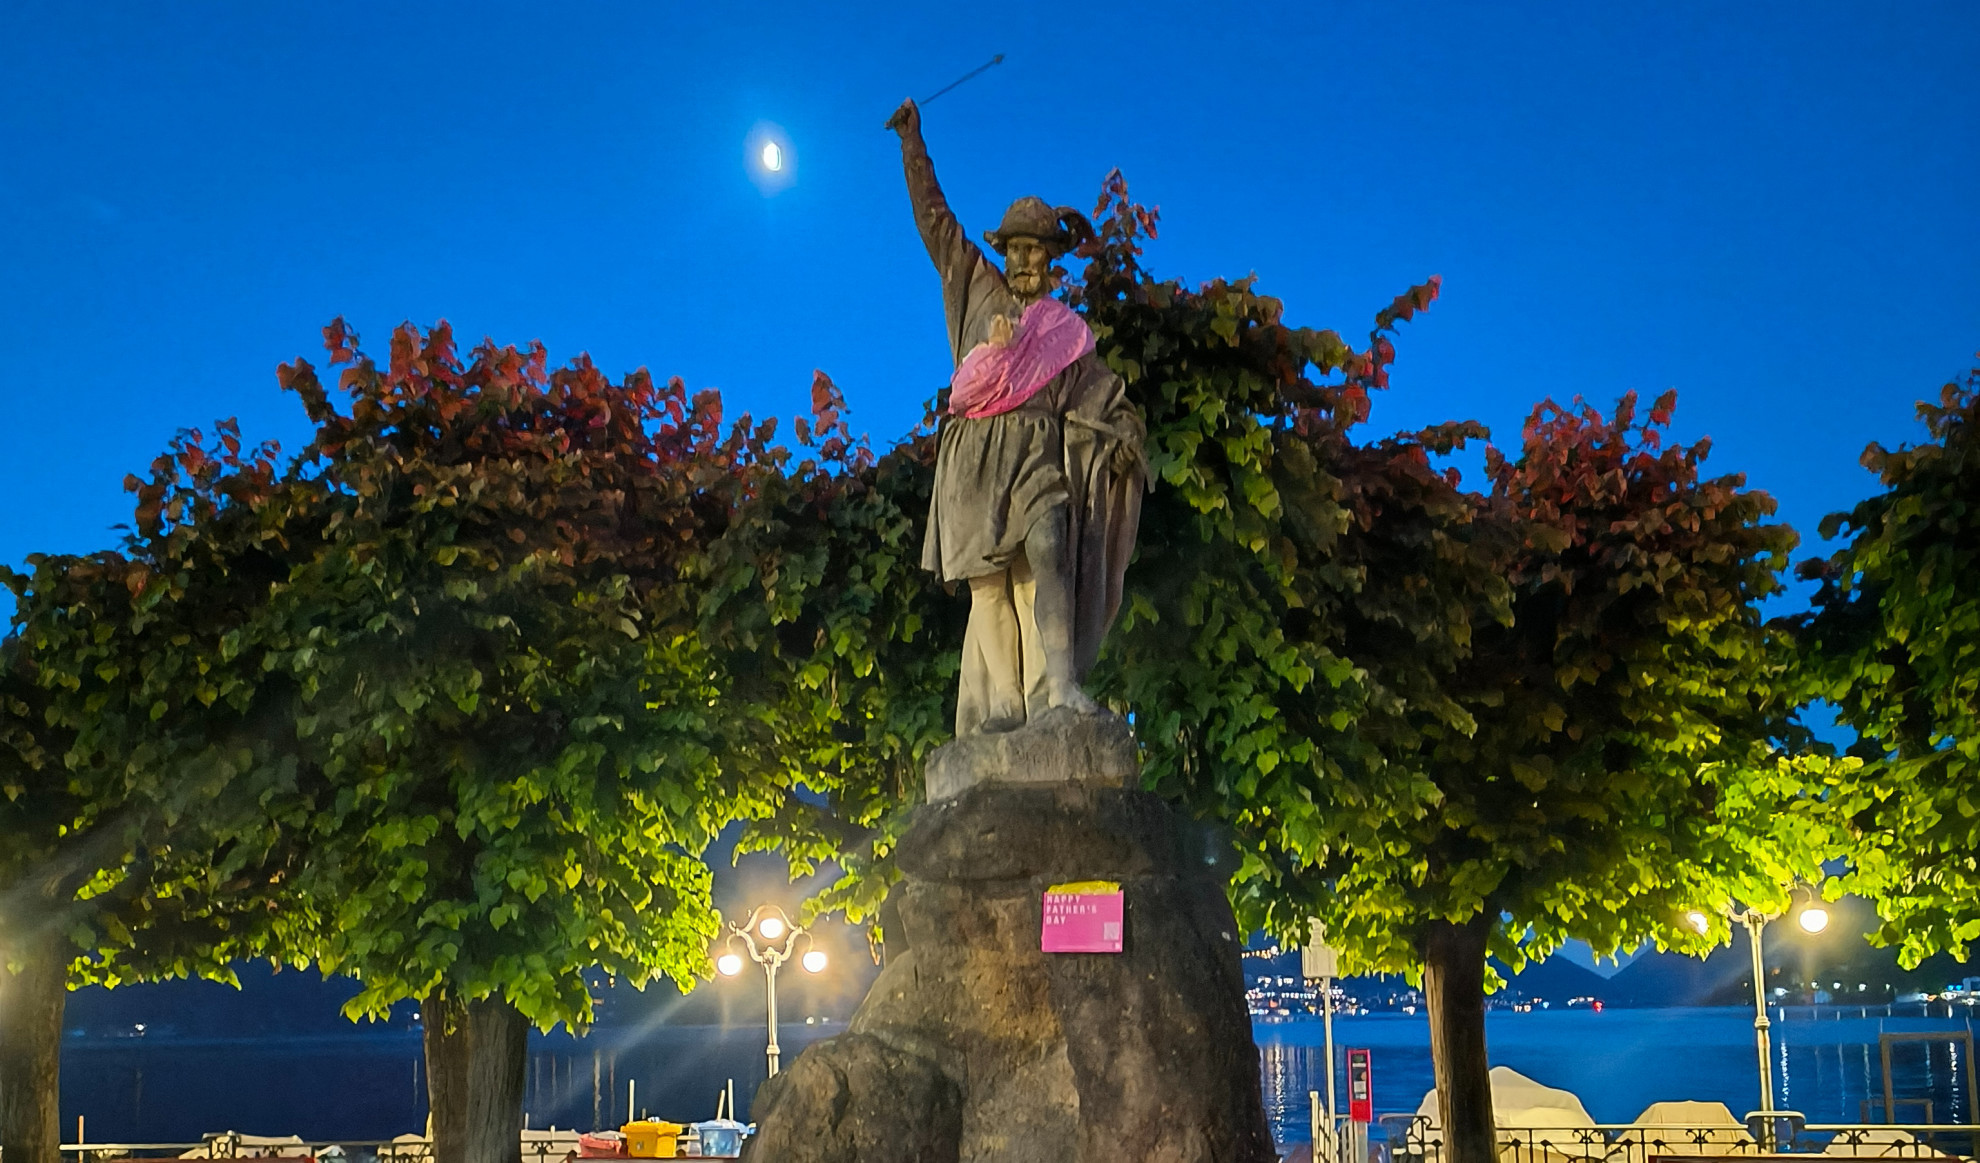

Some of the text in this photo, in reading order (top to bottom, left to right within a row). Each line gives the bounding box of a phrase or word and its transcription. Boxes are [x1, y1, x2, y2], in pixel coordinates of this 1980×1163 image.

[1046, 894, 1081, 904] HAPPY
[1046, 904, 1097, 914] FATHER'S
[1046, 915, 1066, 925] DAY
